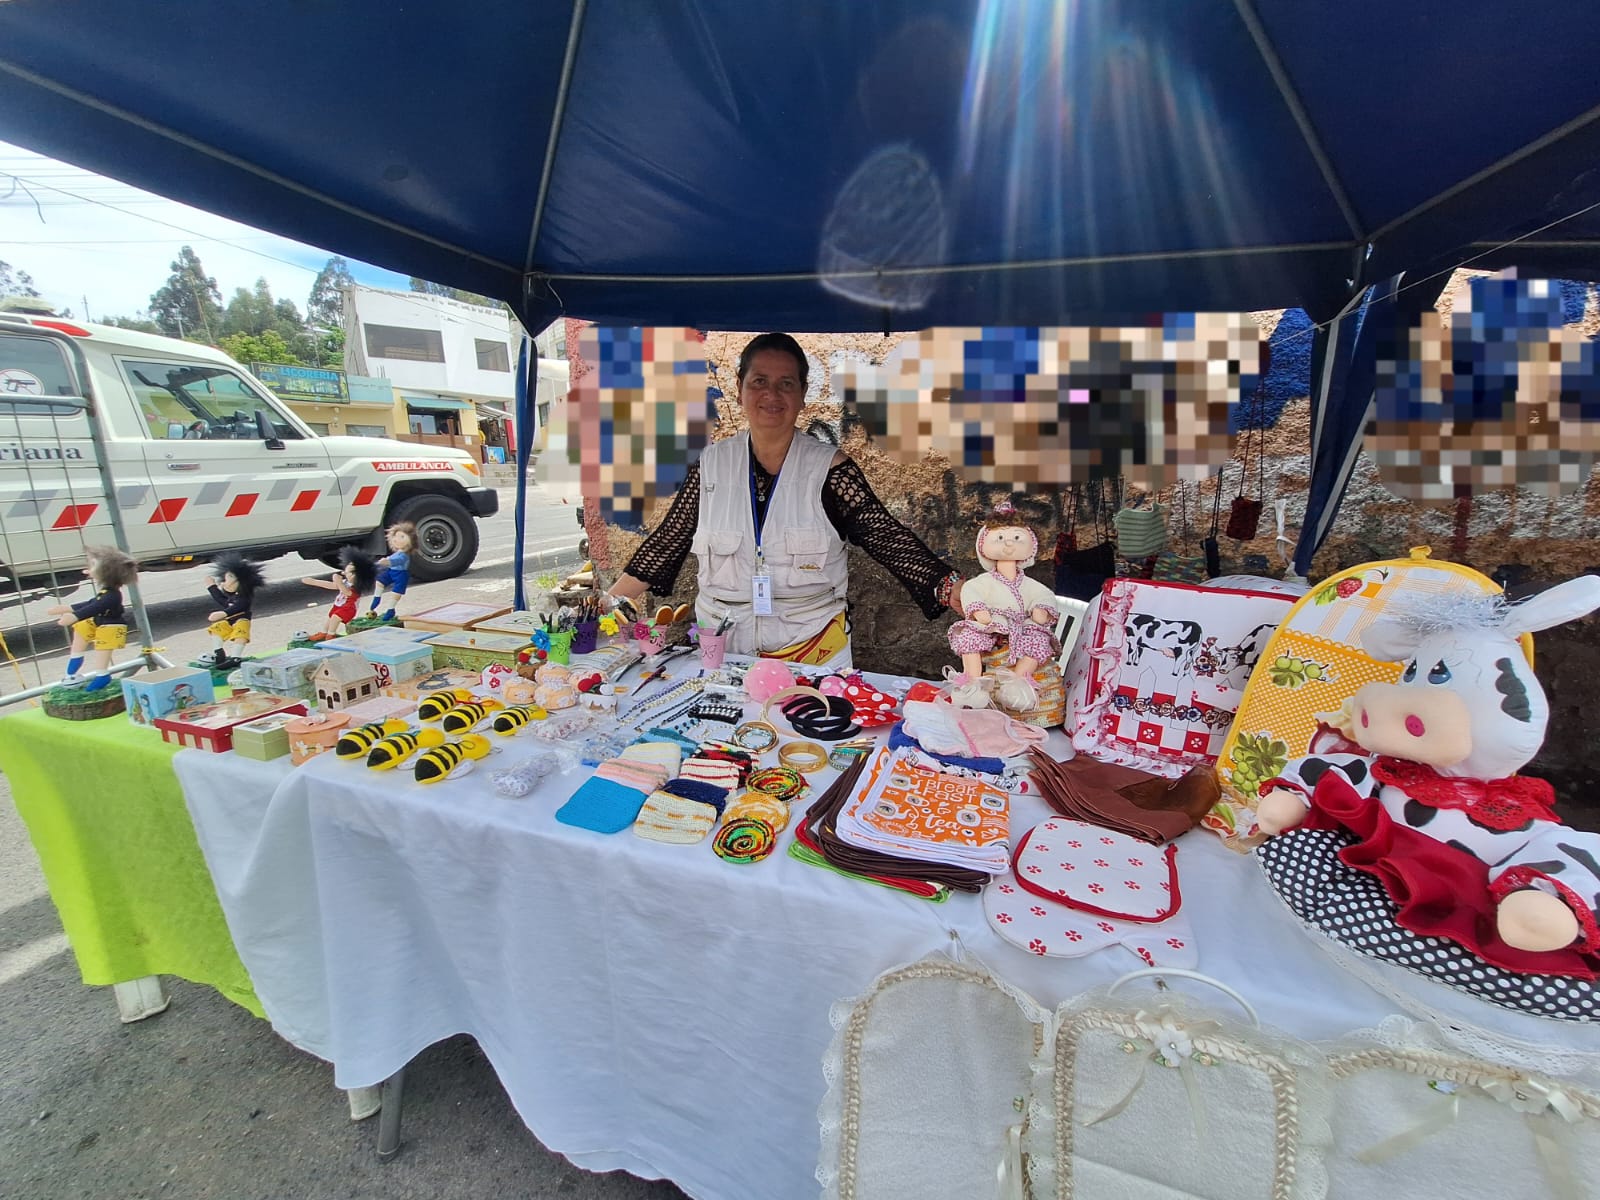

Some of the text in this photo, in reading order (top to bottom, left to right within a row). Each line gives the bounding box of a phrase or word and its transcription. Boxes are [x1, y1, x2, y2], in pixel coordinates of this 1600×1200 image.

[280, 366, 339, 382] LICORERIA
[376, 461, 452, 471] AMBULANCIA
[921, 813, 962, 831] tea
